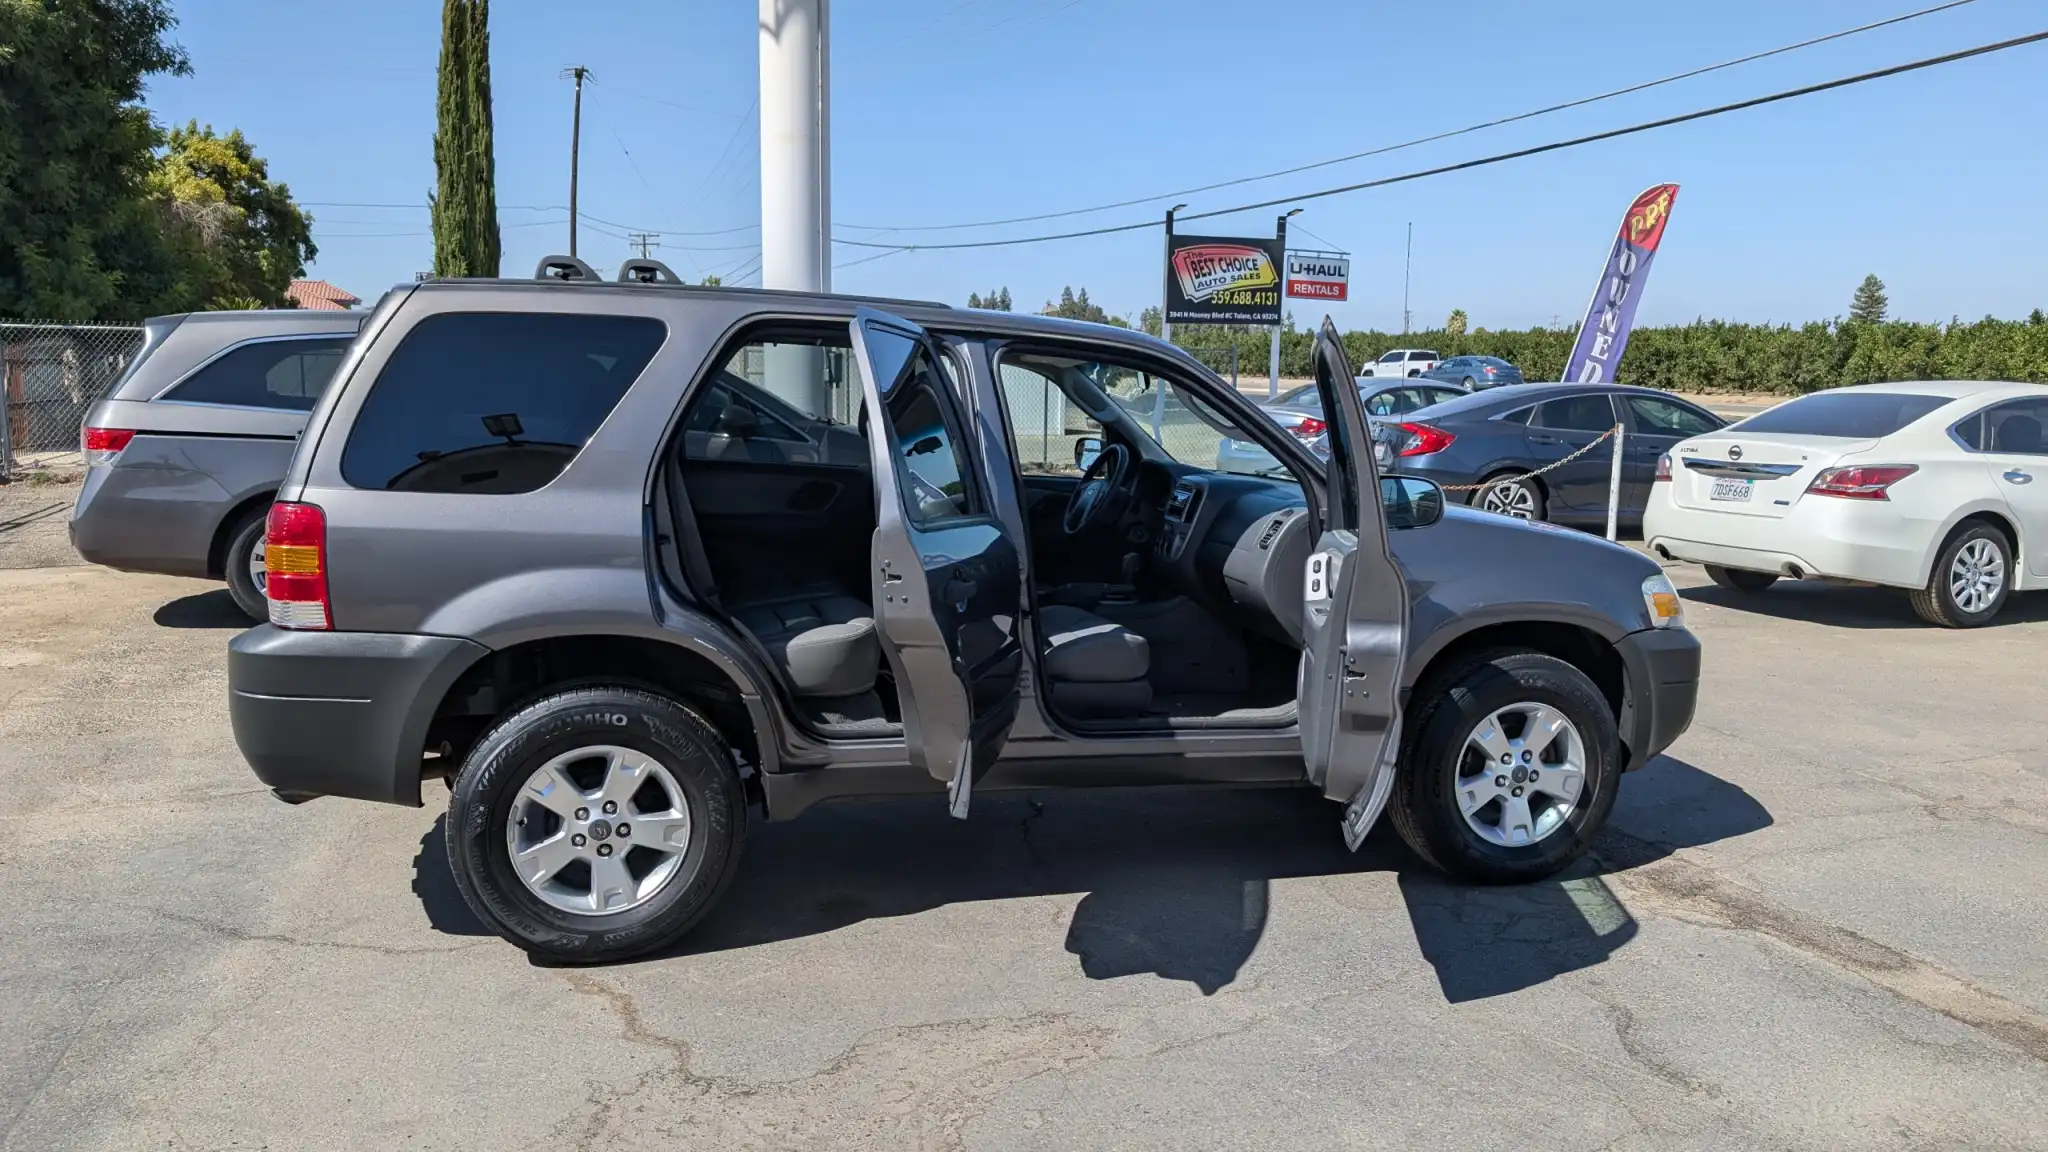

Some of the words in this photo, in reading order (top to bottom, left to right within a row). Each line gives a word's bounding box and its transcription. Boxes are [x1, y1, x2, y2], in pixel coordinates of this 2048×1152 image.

[1631, 191, 1669, 241] PRE
[1186, 252, 1204, 260] The
[1190, 258, 1217, 279] BEST
[1218, 256, 1259, 273] CHOICE
[1290, 262, 1345, 277] U-HAUL
[1197, 276, 1227, 288] AUTO
[1230, 272, 1261, 282] SALES
[1293, 283, 1340, 296] RENTALS
[1211, 290, 1278, 306] 559.688.4131
[1713, 483, 1750, 498] 7DSF668
